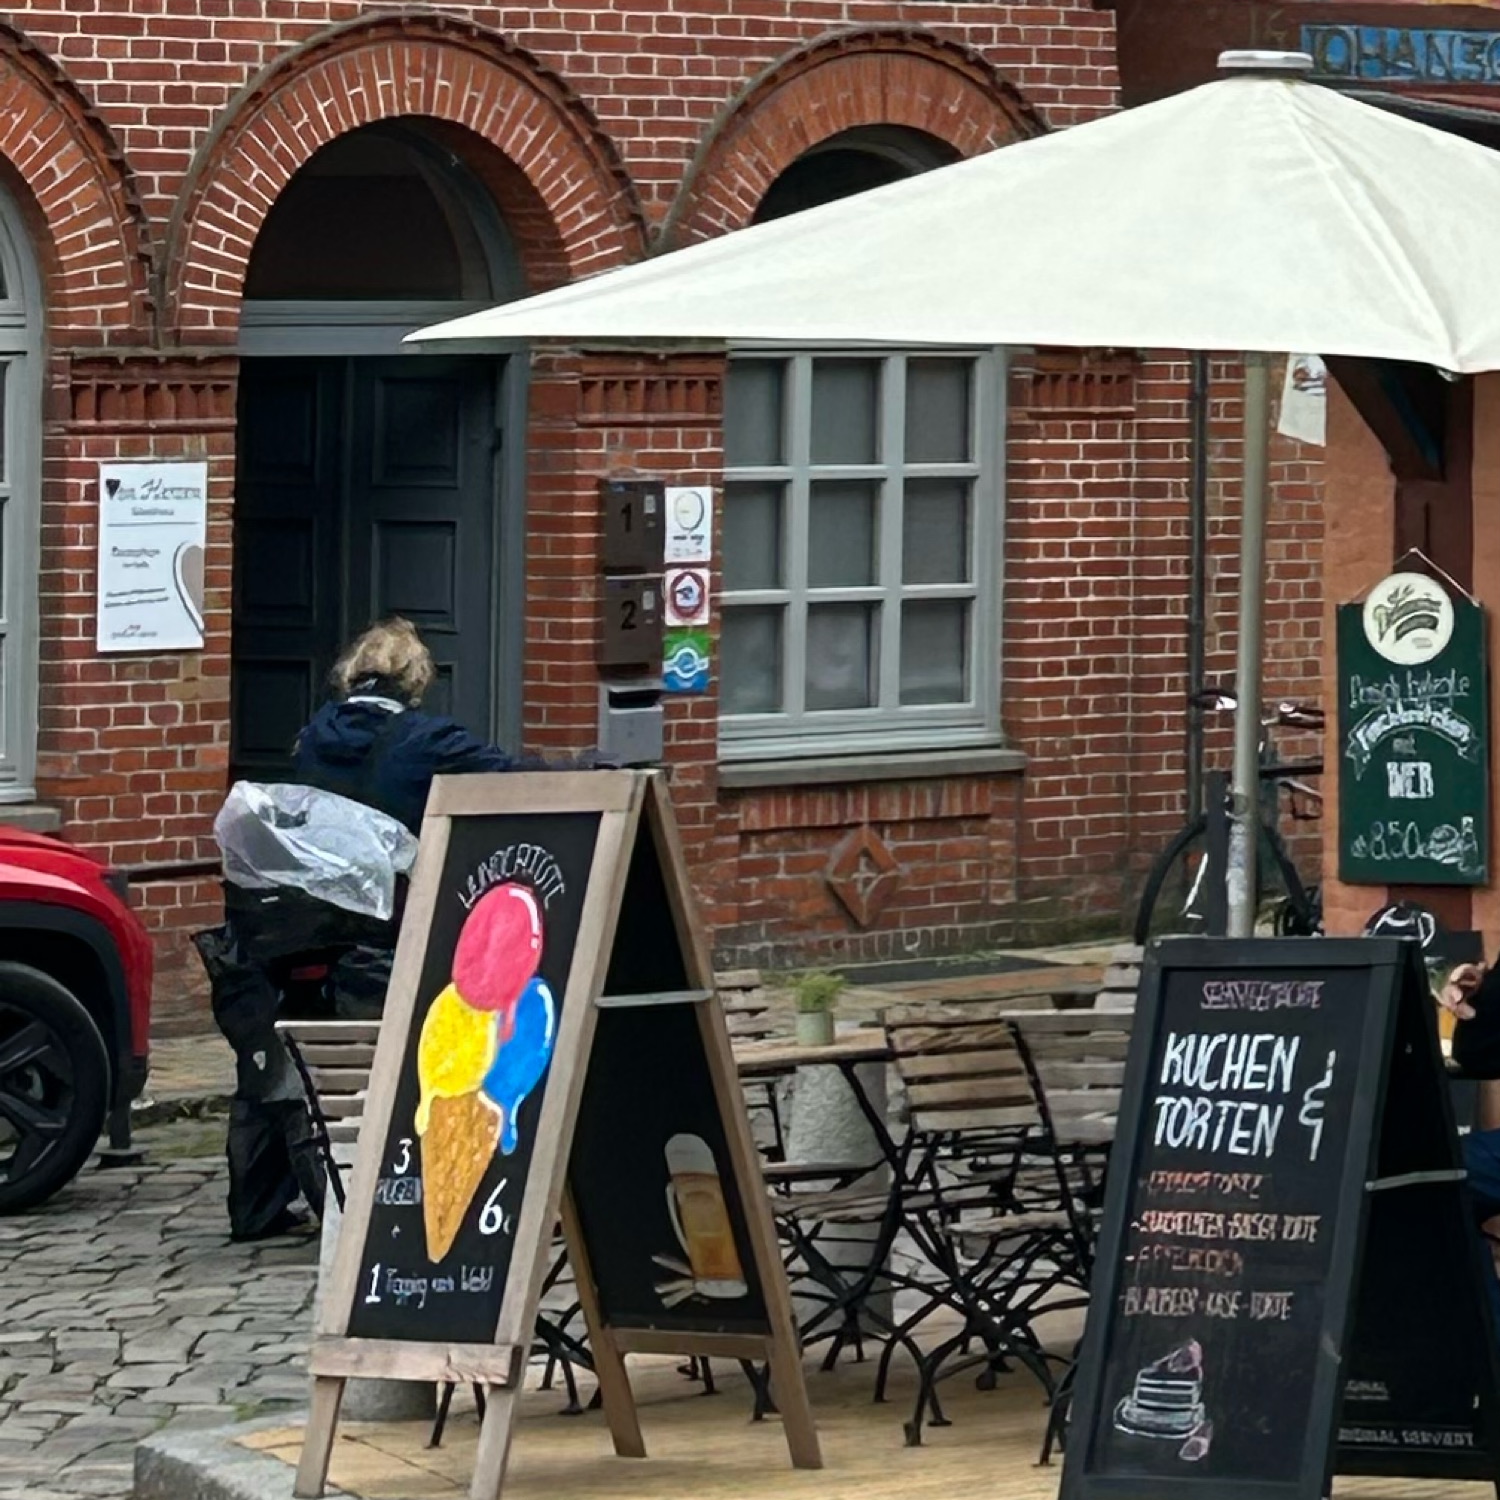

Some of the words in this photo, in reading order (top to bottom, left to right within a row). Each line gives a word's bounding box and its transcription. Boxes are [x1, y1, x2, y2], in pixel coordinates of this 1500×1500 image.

[621, 503, 632, 532] 1
[621, 601, 637, 630] 2
[1160, 1032, 1301, 1093] KUCHEN
[1153, 1096, 1284, 1158] TORTEN
[393, 1138, 413, 1175] 3
